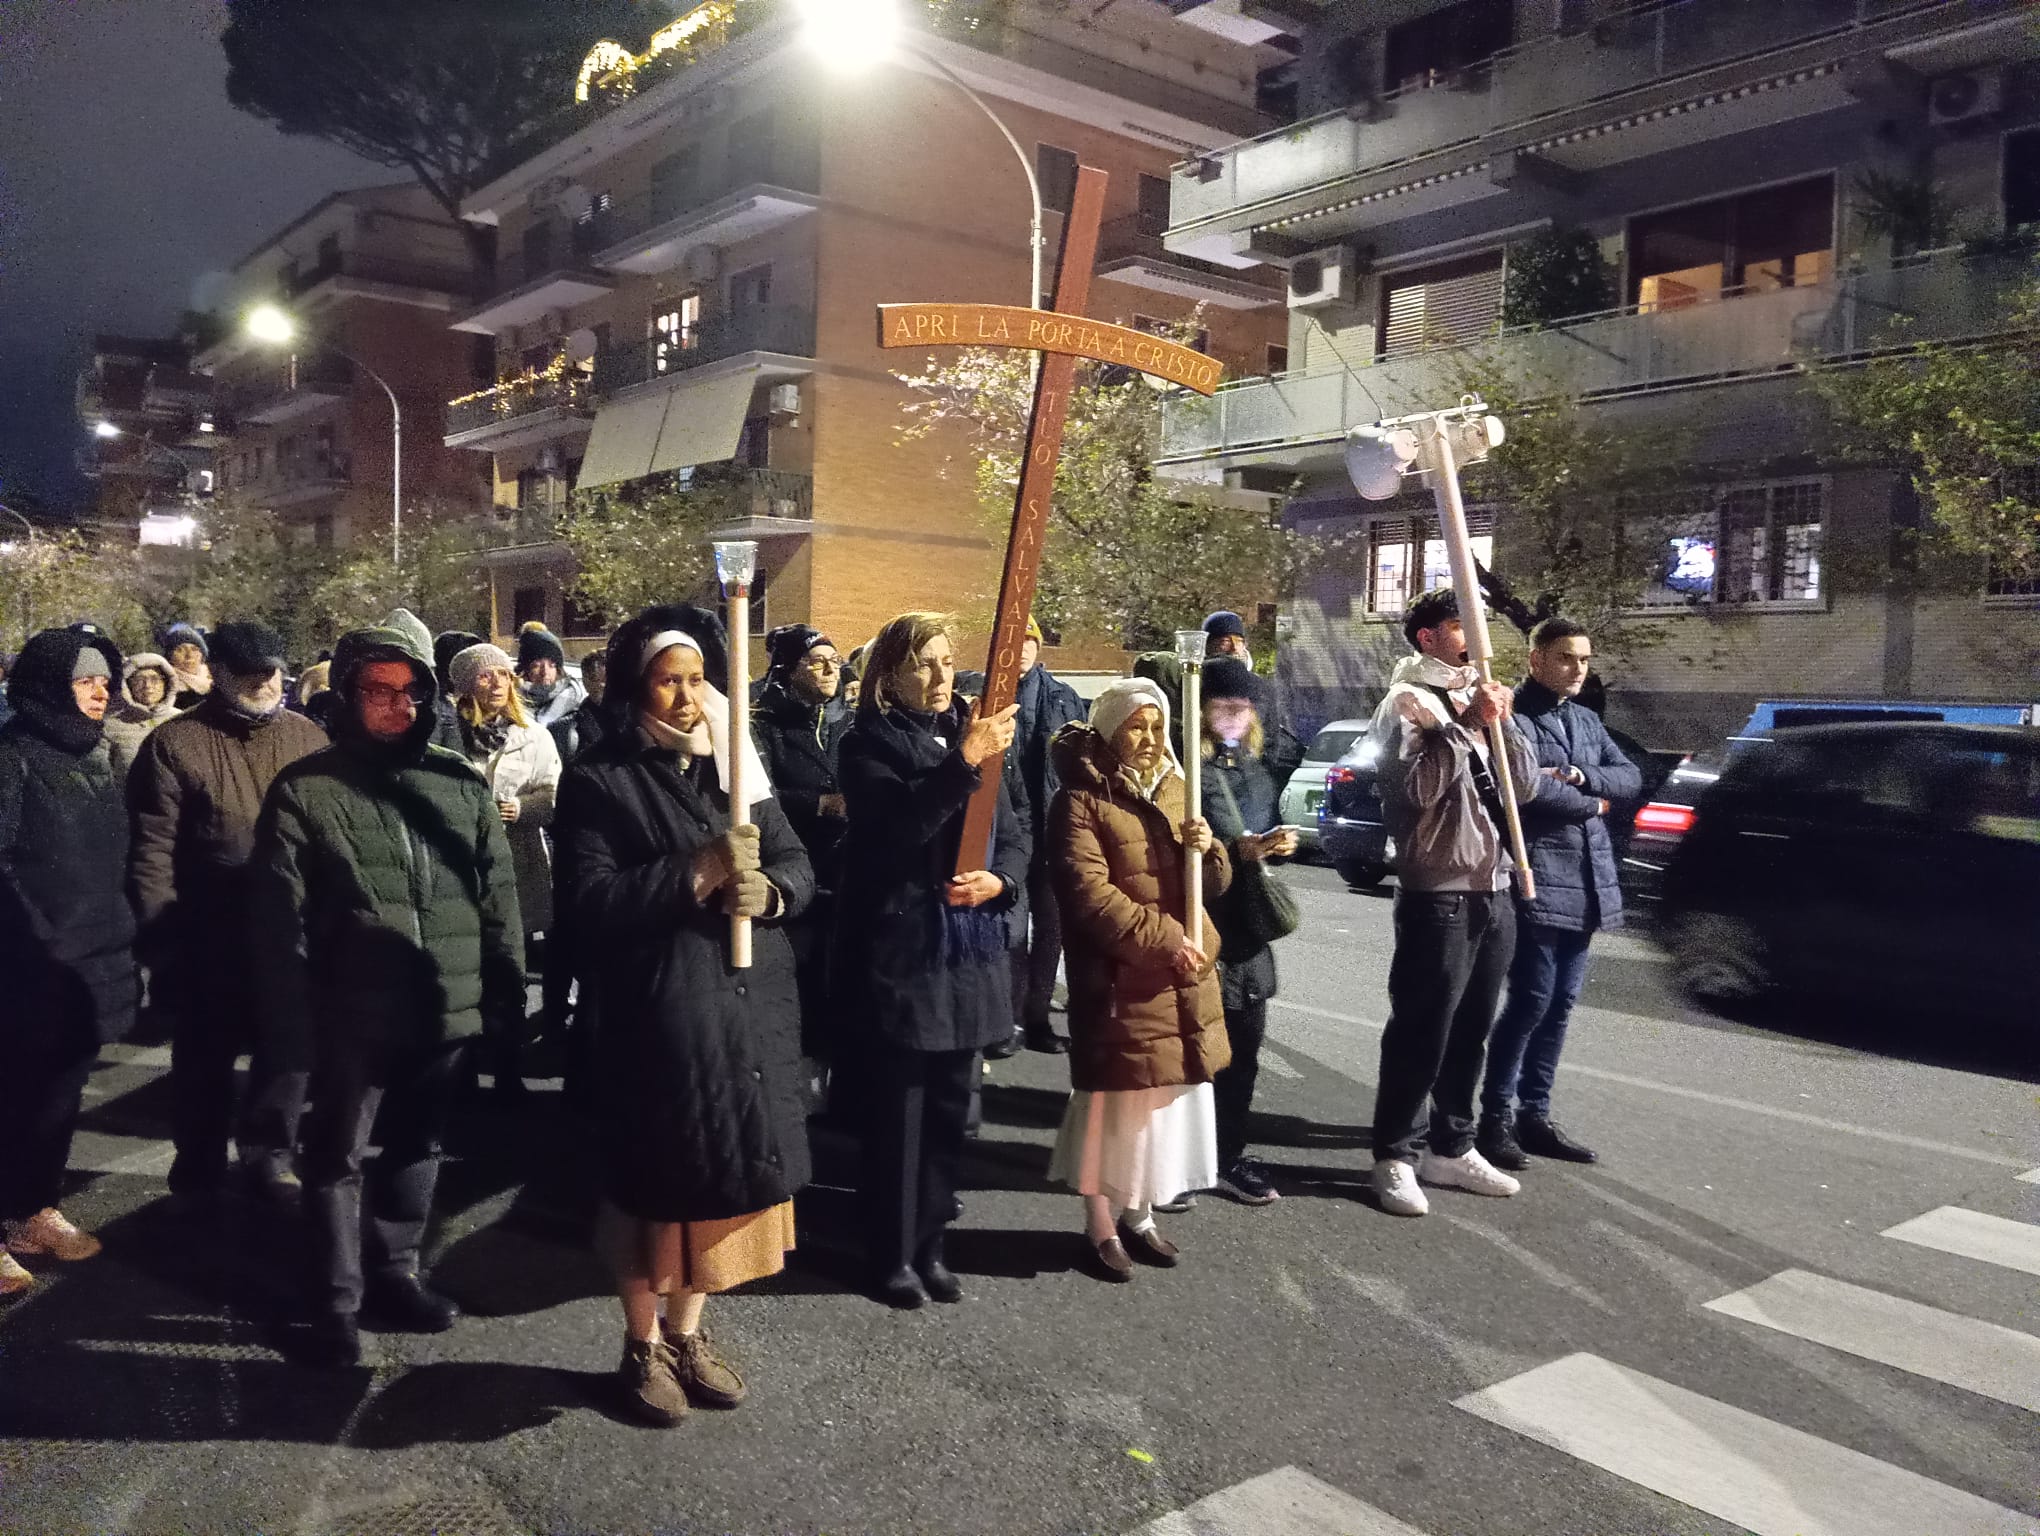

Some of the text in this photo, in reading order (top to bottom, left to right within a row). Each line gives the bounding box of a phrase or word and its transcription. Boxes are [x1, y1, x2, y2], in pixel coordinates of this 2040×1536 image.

[894, 314, 1213, 386] APRI LA PORTA A CRISTO
[992, 499, 1039, 716] SALVATORE
